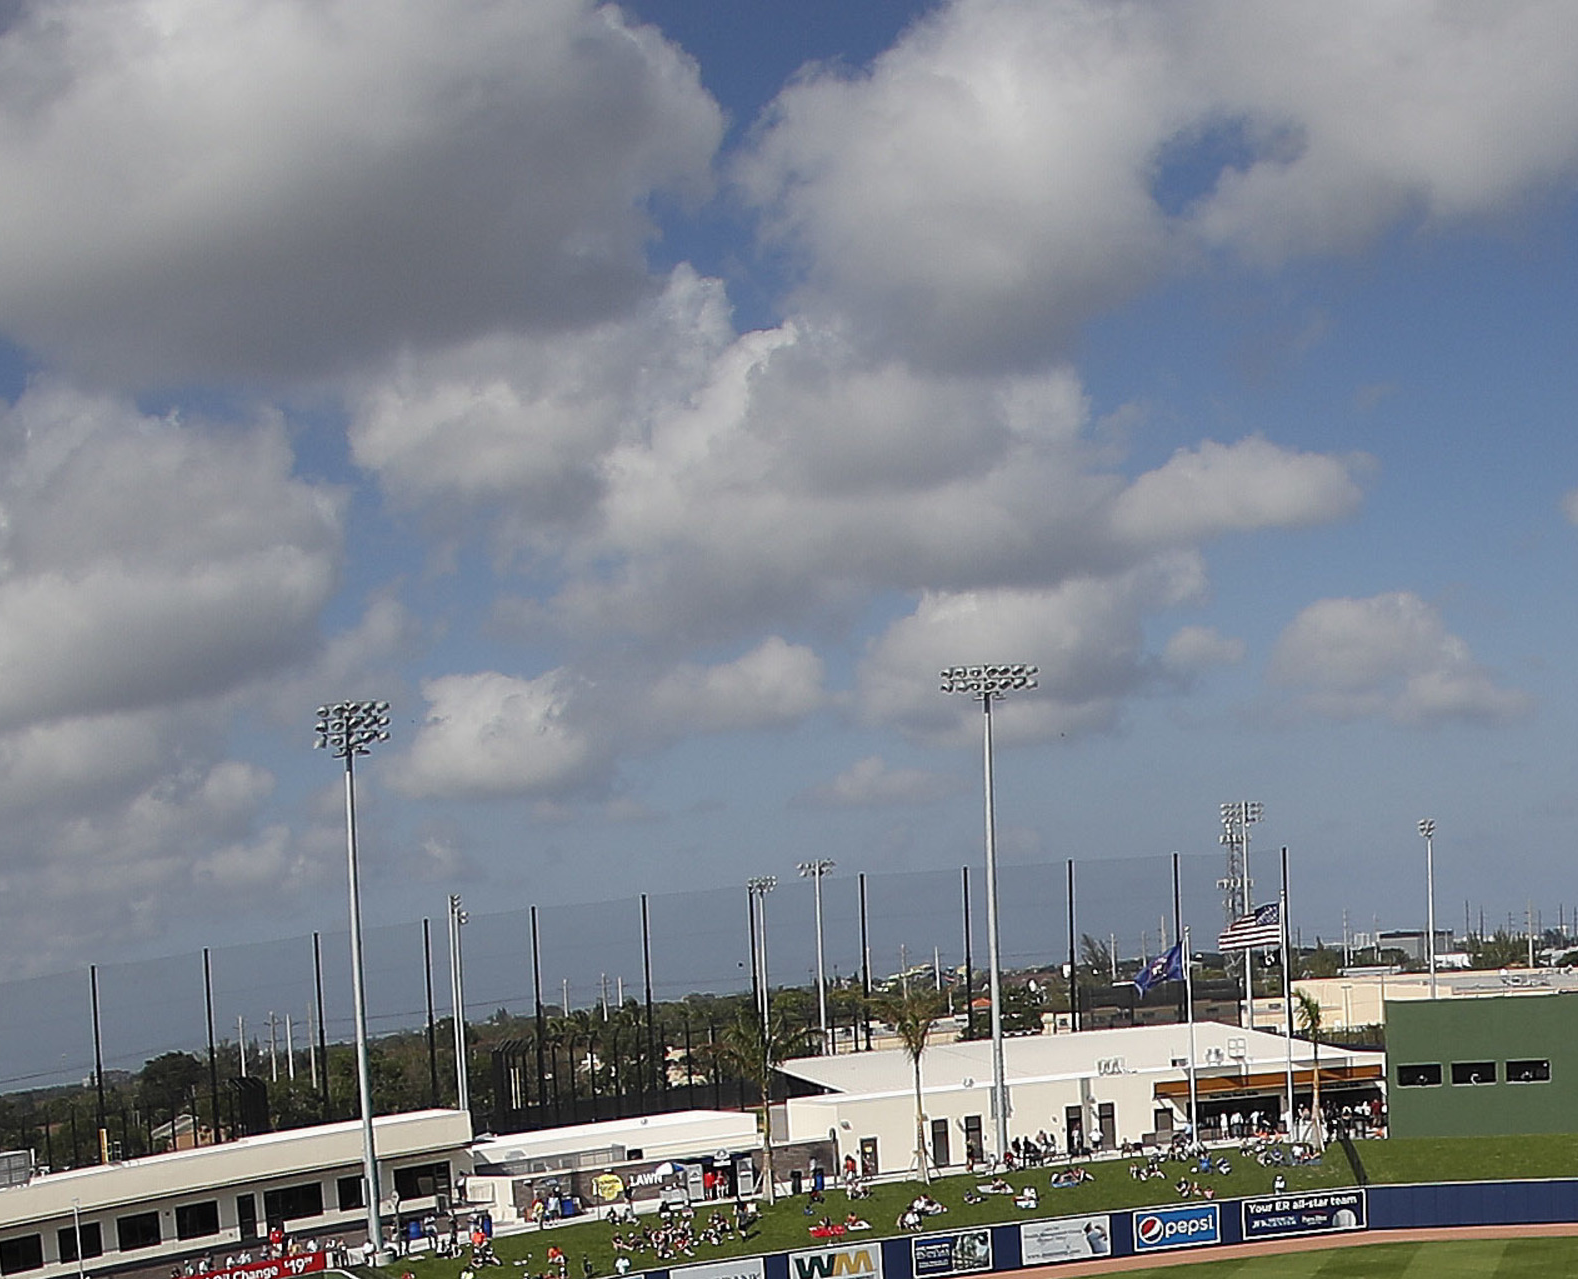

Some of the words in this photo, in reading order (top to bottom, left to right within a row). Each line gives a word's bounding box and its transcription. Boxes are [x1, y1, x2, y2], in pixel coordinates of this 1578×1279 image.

[629, 1174, 663, 1187] LAWN
[1248, 1202, 1273, 1214] Your
[1275, 1200, 1290, 1212] ER
[1292, 1198, 1328, 1210] all-star
[1331, 1195, 1358, 1207] team
[1165, 1215, 1215, 1238] pepsi
